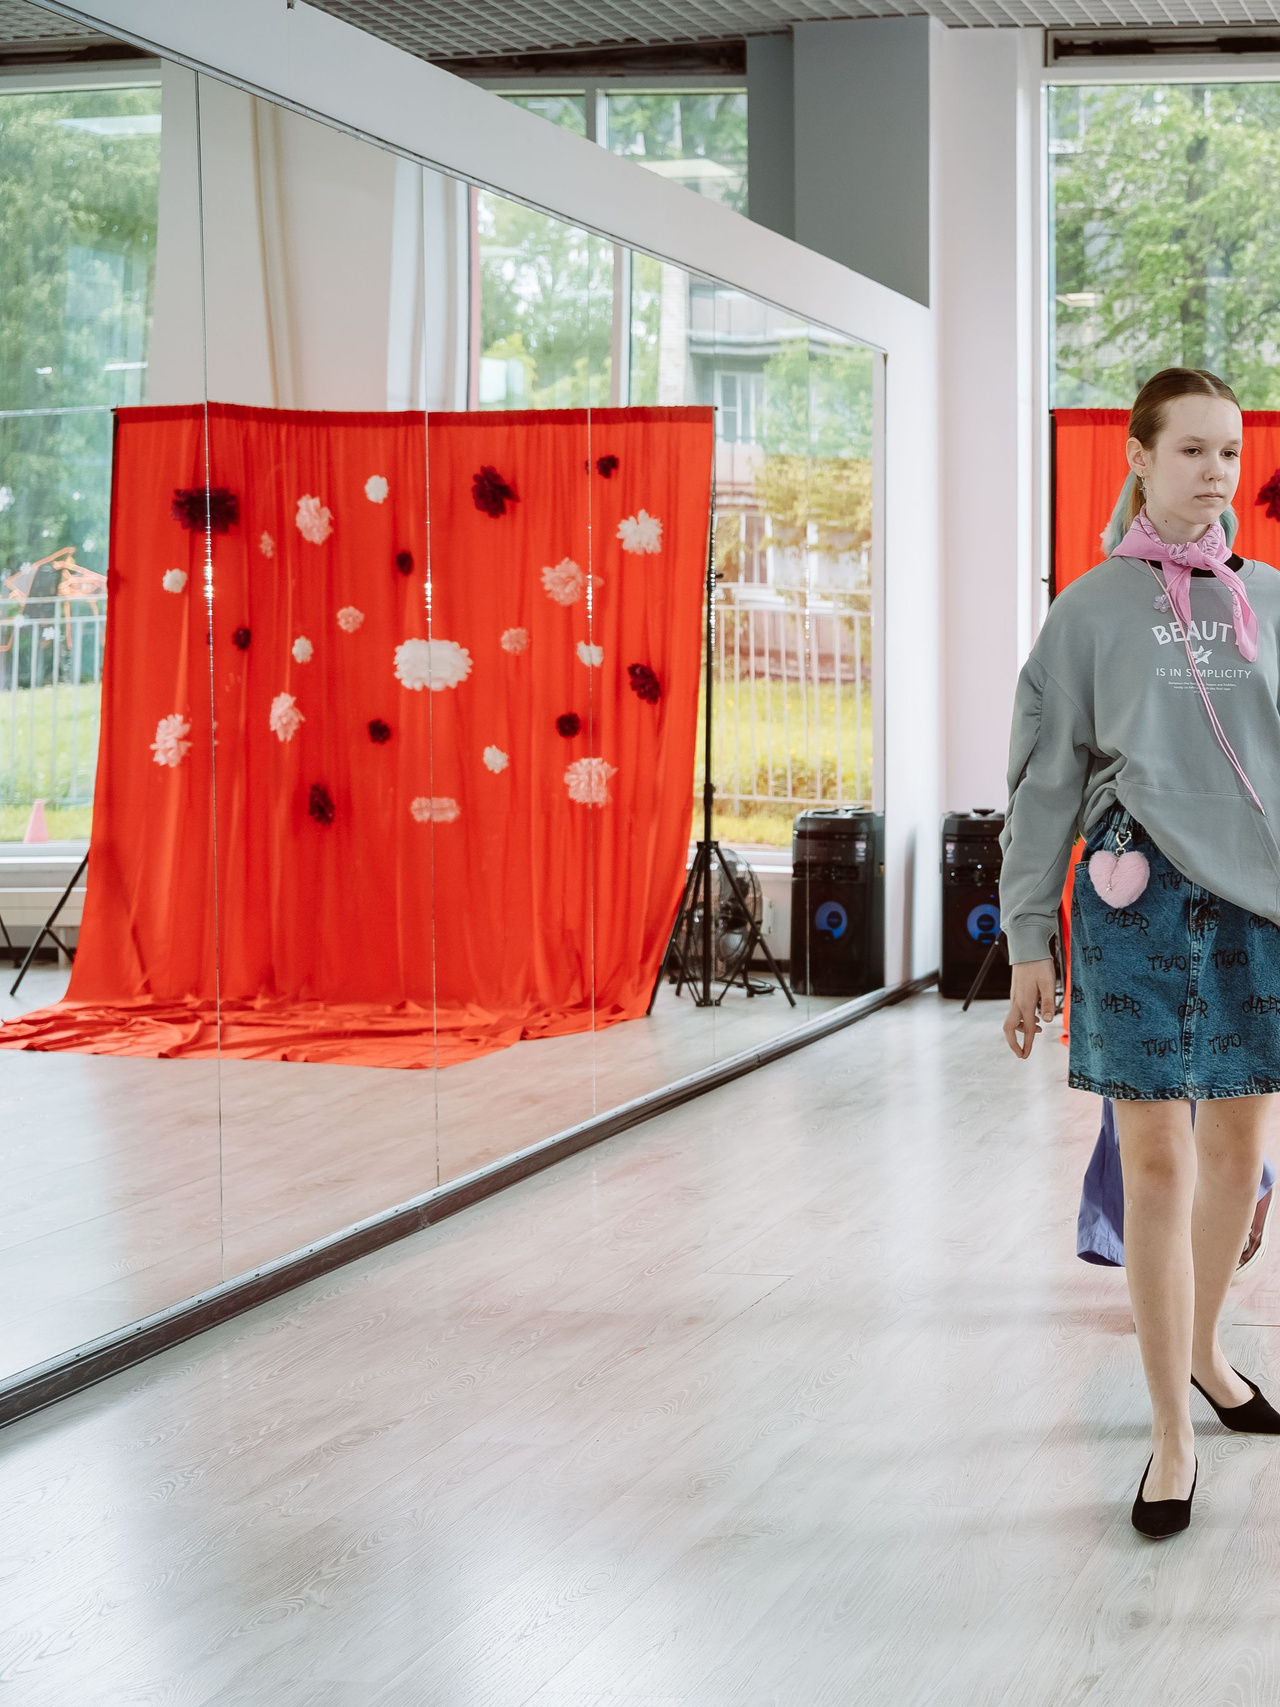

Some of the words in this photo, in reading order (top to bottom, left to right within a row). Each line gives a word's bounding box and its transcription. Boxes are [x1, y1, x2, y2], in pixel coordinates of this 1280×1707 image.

[1152, 621, 1234, 645] BEAUT
[1156, 668, 1166, 677] IS
[1170, 668, 1182, 677] IN
[1186, 668, 1252, 679] SMPLICITY
[1105, 908, 1150, 936] CHEER
[1101, 991, 1142, 1019] CHEER
